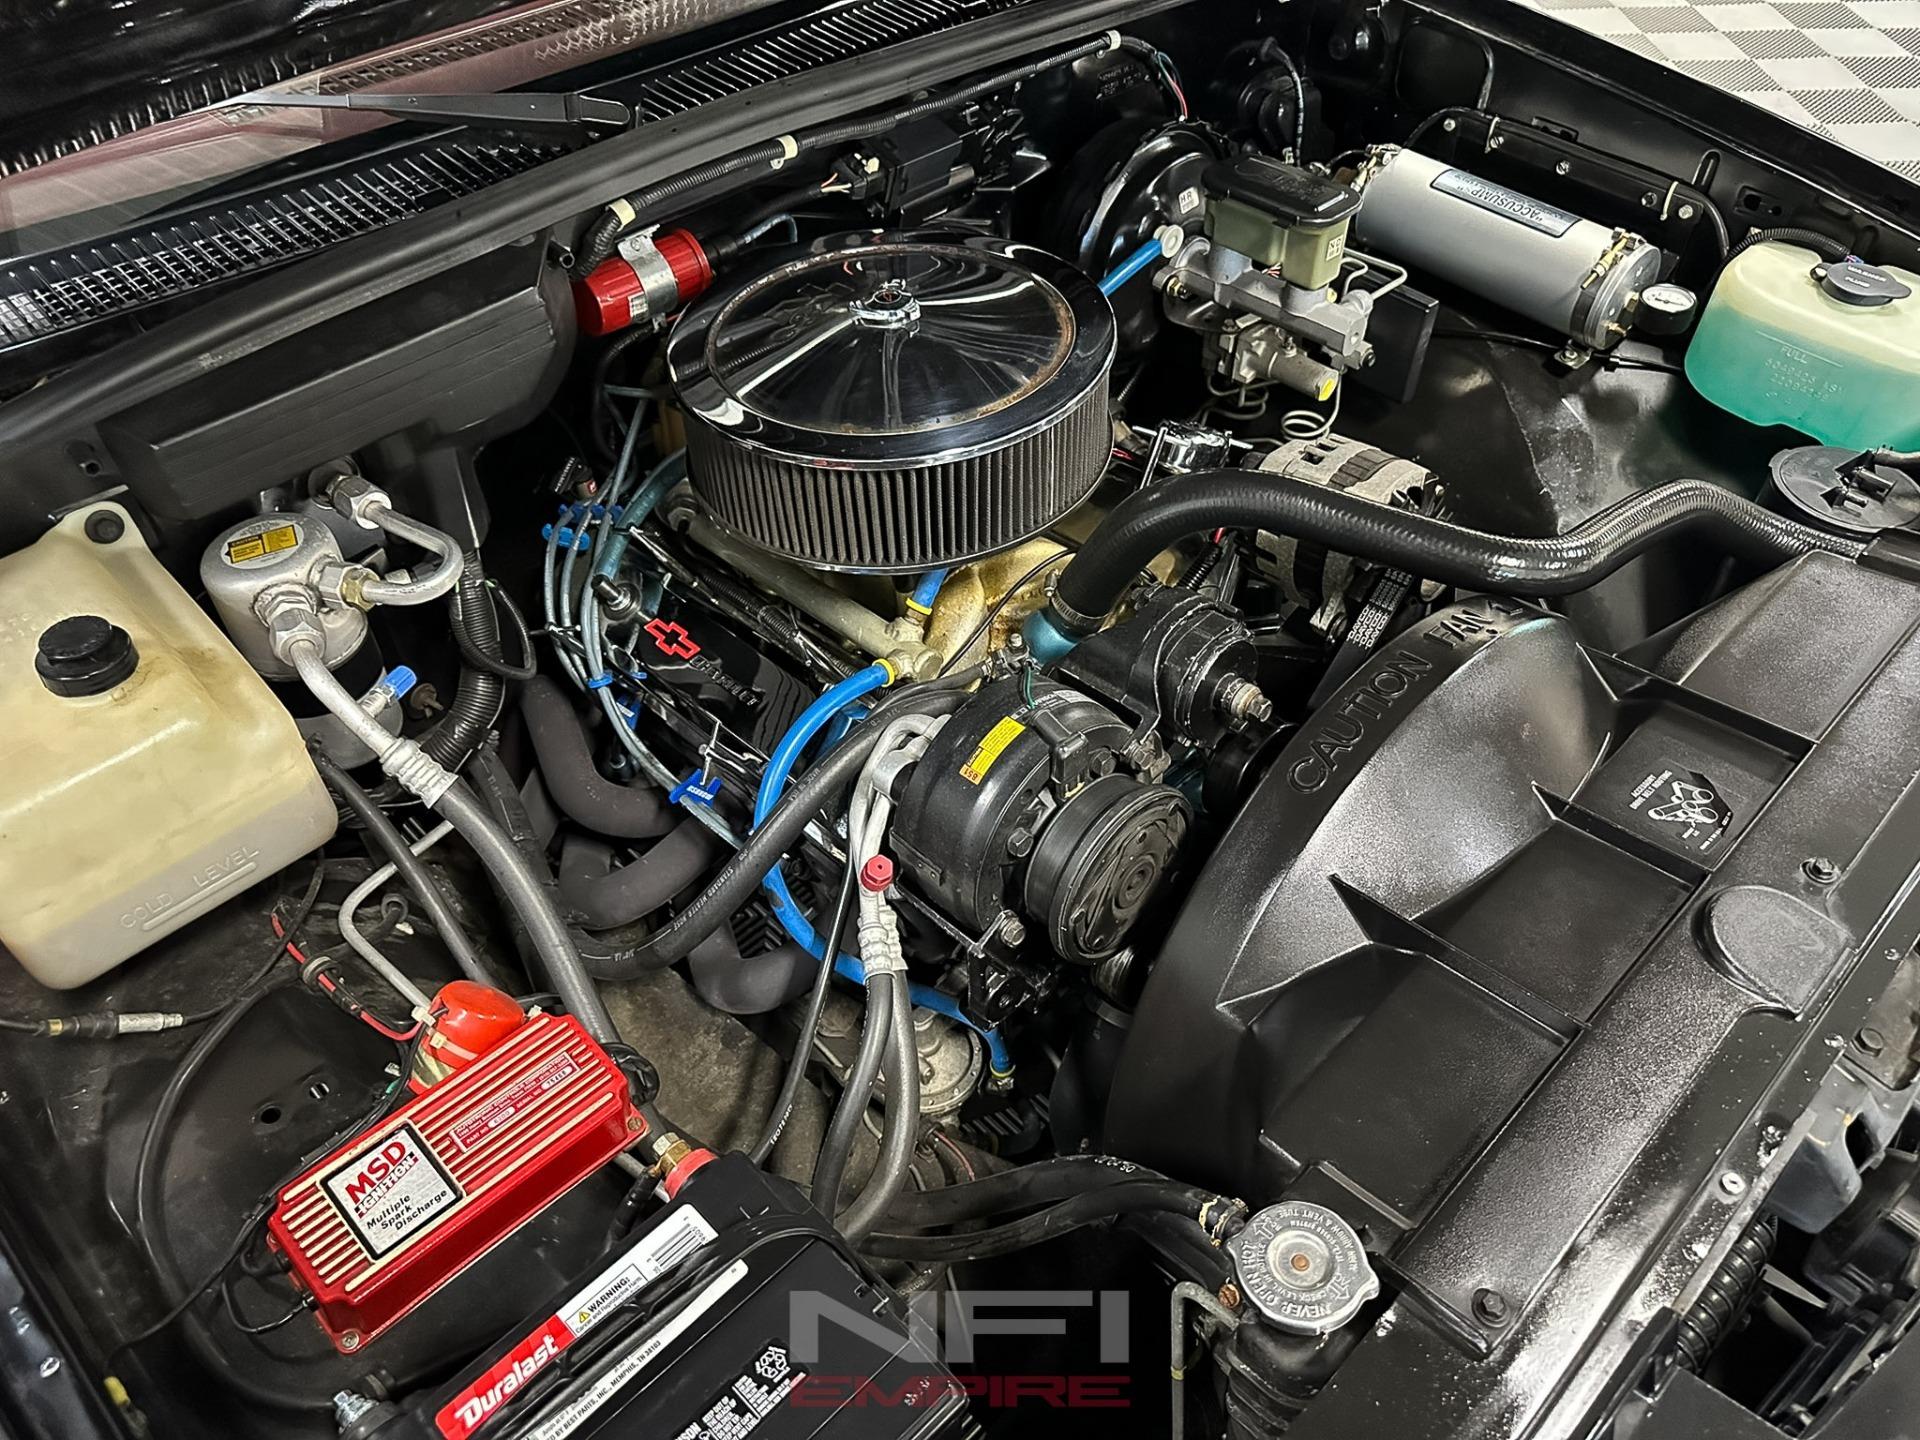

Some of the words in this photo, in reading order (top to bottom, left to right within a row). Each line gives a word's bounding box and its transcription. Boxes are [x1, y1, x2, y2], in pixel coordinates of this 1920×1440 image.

[1287, 650, 1433, 794] CAUTION
[1422, 608, 1494, 649] FAN
[120, 892, 172, 928] COLD
[193, 847, 260, 887] LEVEL
[344, 1139, 409, 1204] MSD
[358, 1155, 416, 1215] IGNITION
[364, 1193, 411, 1230] Multiple
[380, 1203, 414, 1231] Spark
[393, 1188, 449, 1231] Discharge
[587, 1275, 630, 1313] WARNING:
[591, 1309, 601, 1319] and
[599, 1286, 630, 1312] Reproductive
[1246, 1272, 1279, 1306] OPEN
[1281, 1301, 1332, 1318] NEVER
[452, 1332, 562, 1431] Duralast
[554, 1426, 564, 1436] BY
[562, 1413, 579, 1429] BEST
[609, 1360, 639, 1387] MEMPHIS,
